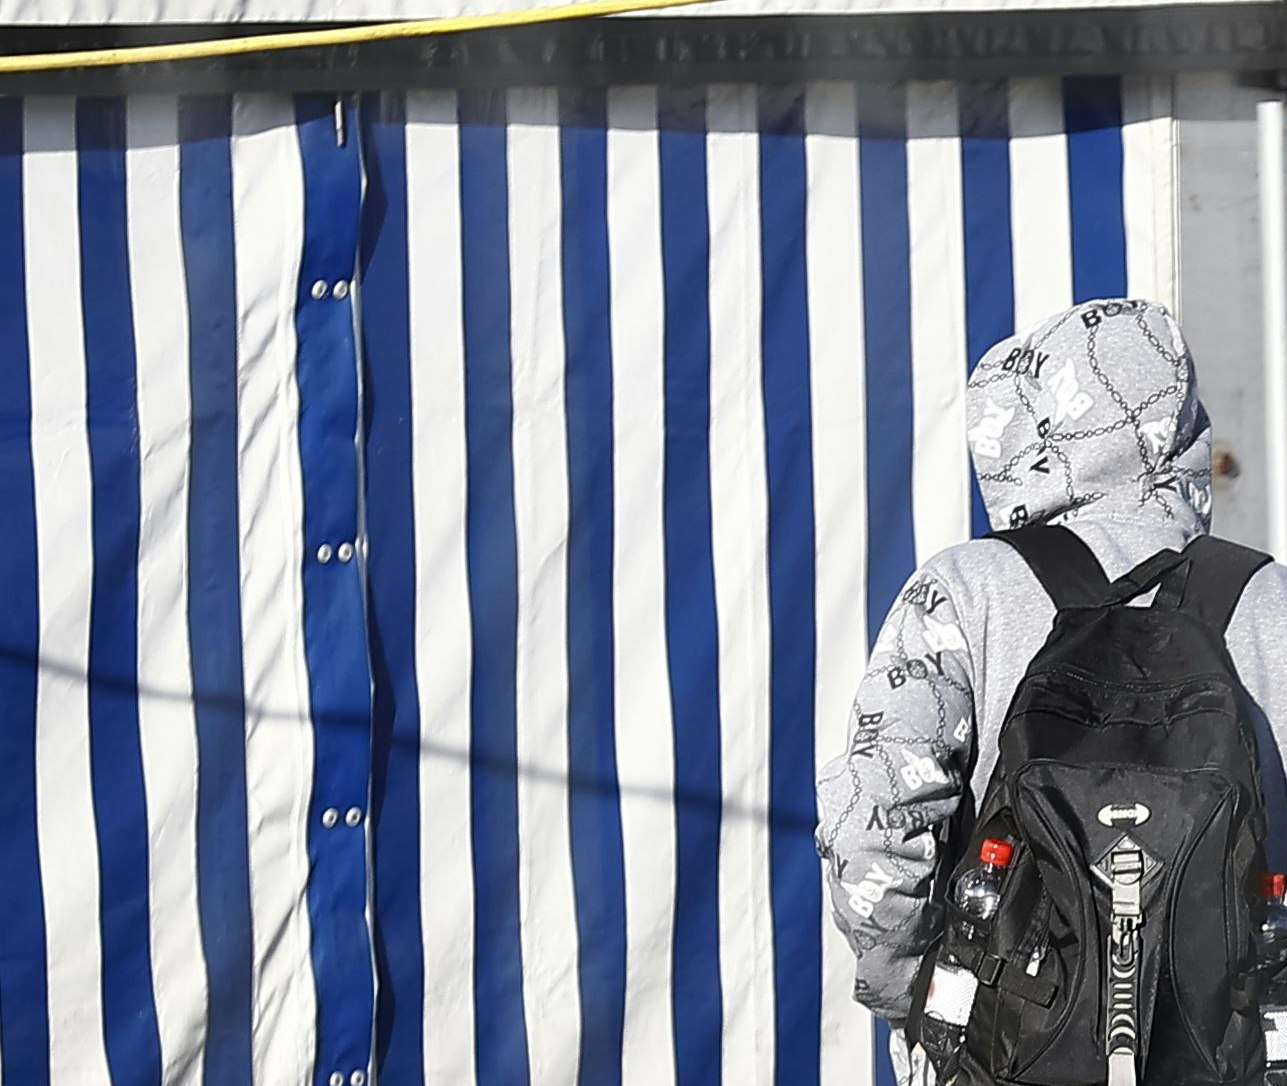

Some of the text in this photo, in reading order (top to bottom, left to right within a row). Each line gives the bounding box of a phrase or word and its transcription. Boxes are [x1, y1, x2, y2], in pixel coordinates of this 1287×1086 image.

[1080, 300, 1137, 329] BO
[1001, 347, 1050, 379] BOY
[887, 651, 945, 690] BOY
[850, 711, 884, 758] BOY
[848, 862, 893, 919] BOY
